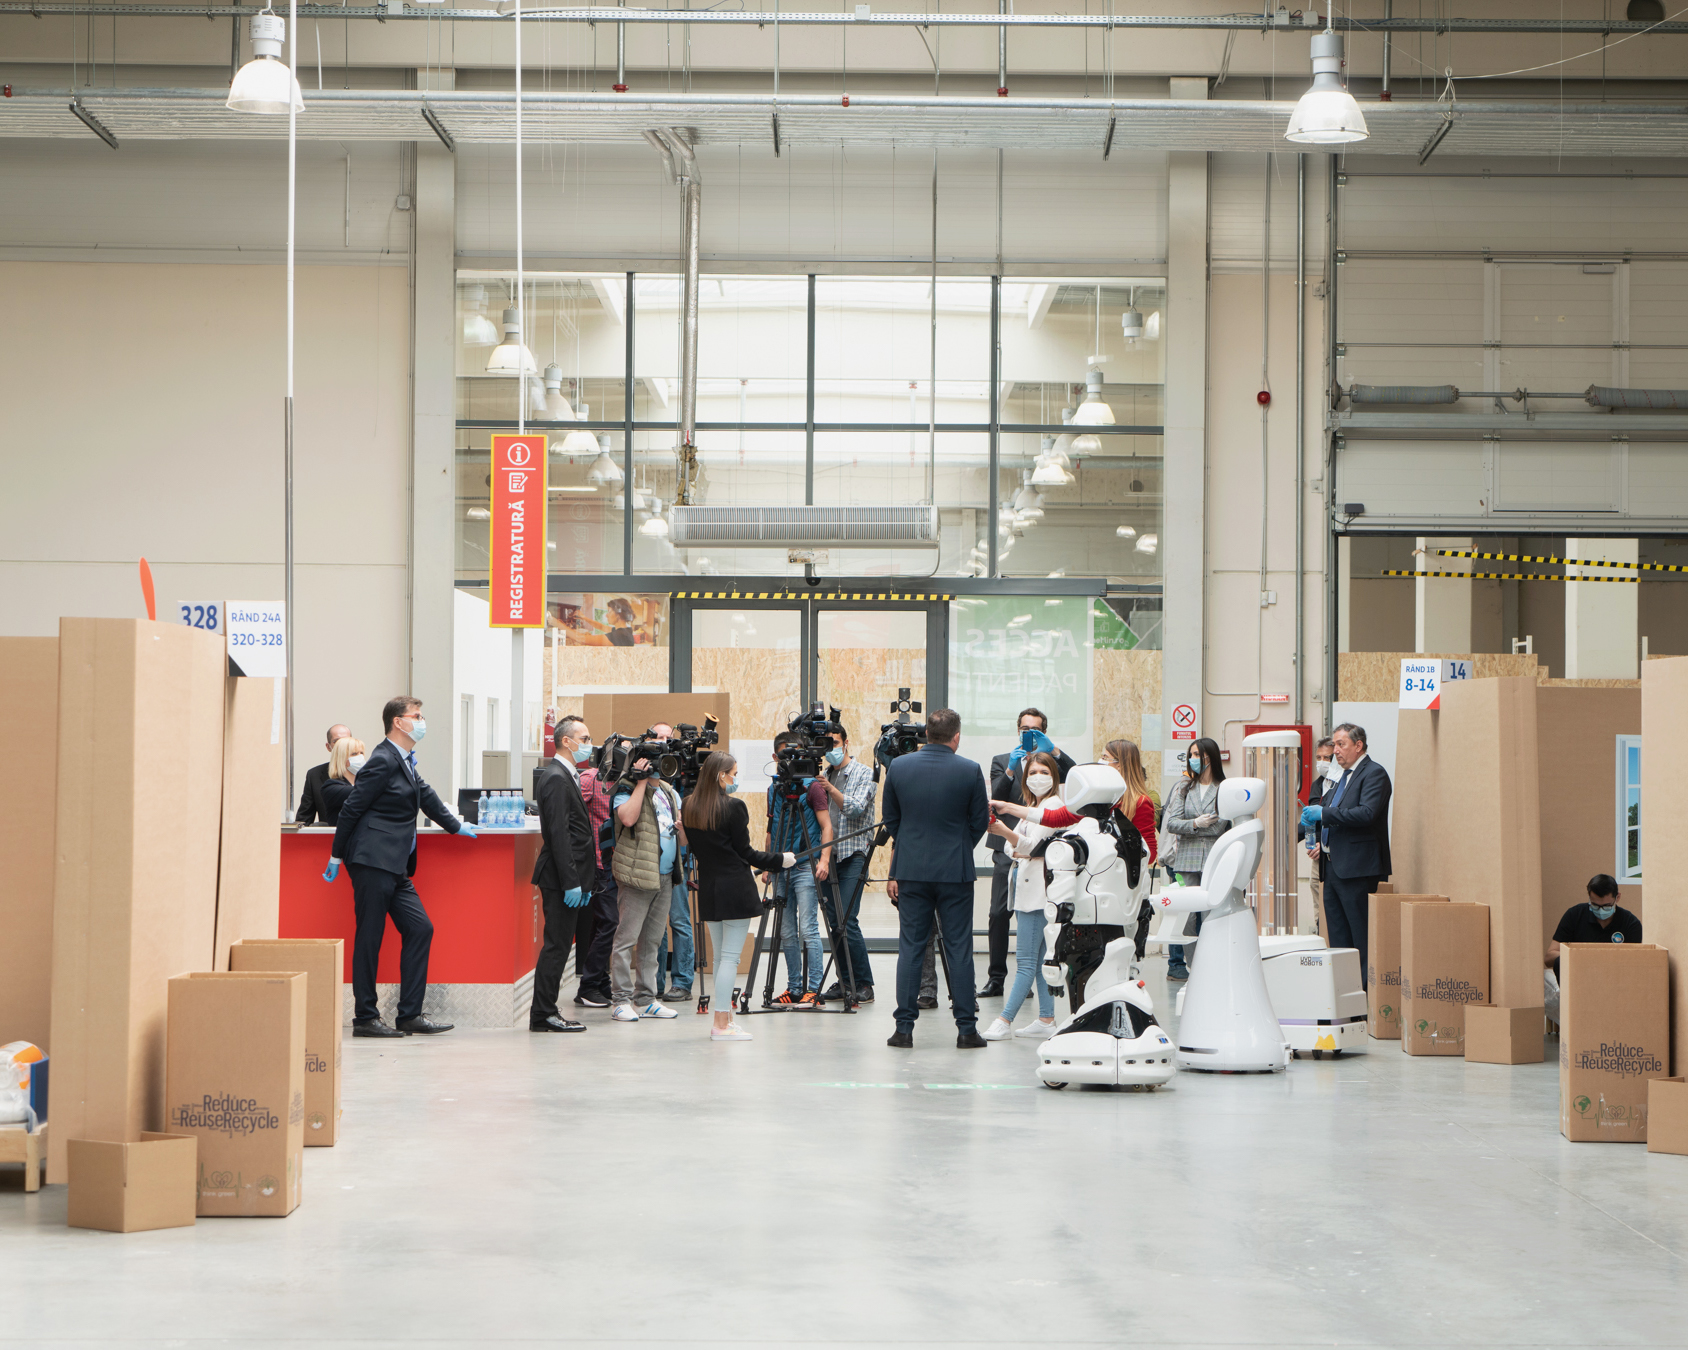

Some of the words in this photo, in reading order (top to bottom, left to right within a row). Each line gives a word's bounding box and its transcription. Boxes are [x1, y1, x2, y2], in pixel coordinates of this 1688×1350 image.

[508, 500, 525, 619] REGISTRATURĂ
[181, 604, 218, 630] 328
[231, 610, 260, 623] RÂND
[262, 612, 282, 623] 24A
[231, 633, 283, 646] 320-328
[1405, 664, 1426, 673] RÂND
[1426, 665, 1436, 673] 1B
[1450, 662, 1467, 680] 14
[1405, 678, 1435, 691] 8-14
[1435, 978, 1470, 991] Reduce
[1600, 1042, 1644, 1058] Reduce
[203, 1093, 257, 1112] Reduce
